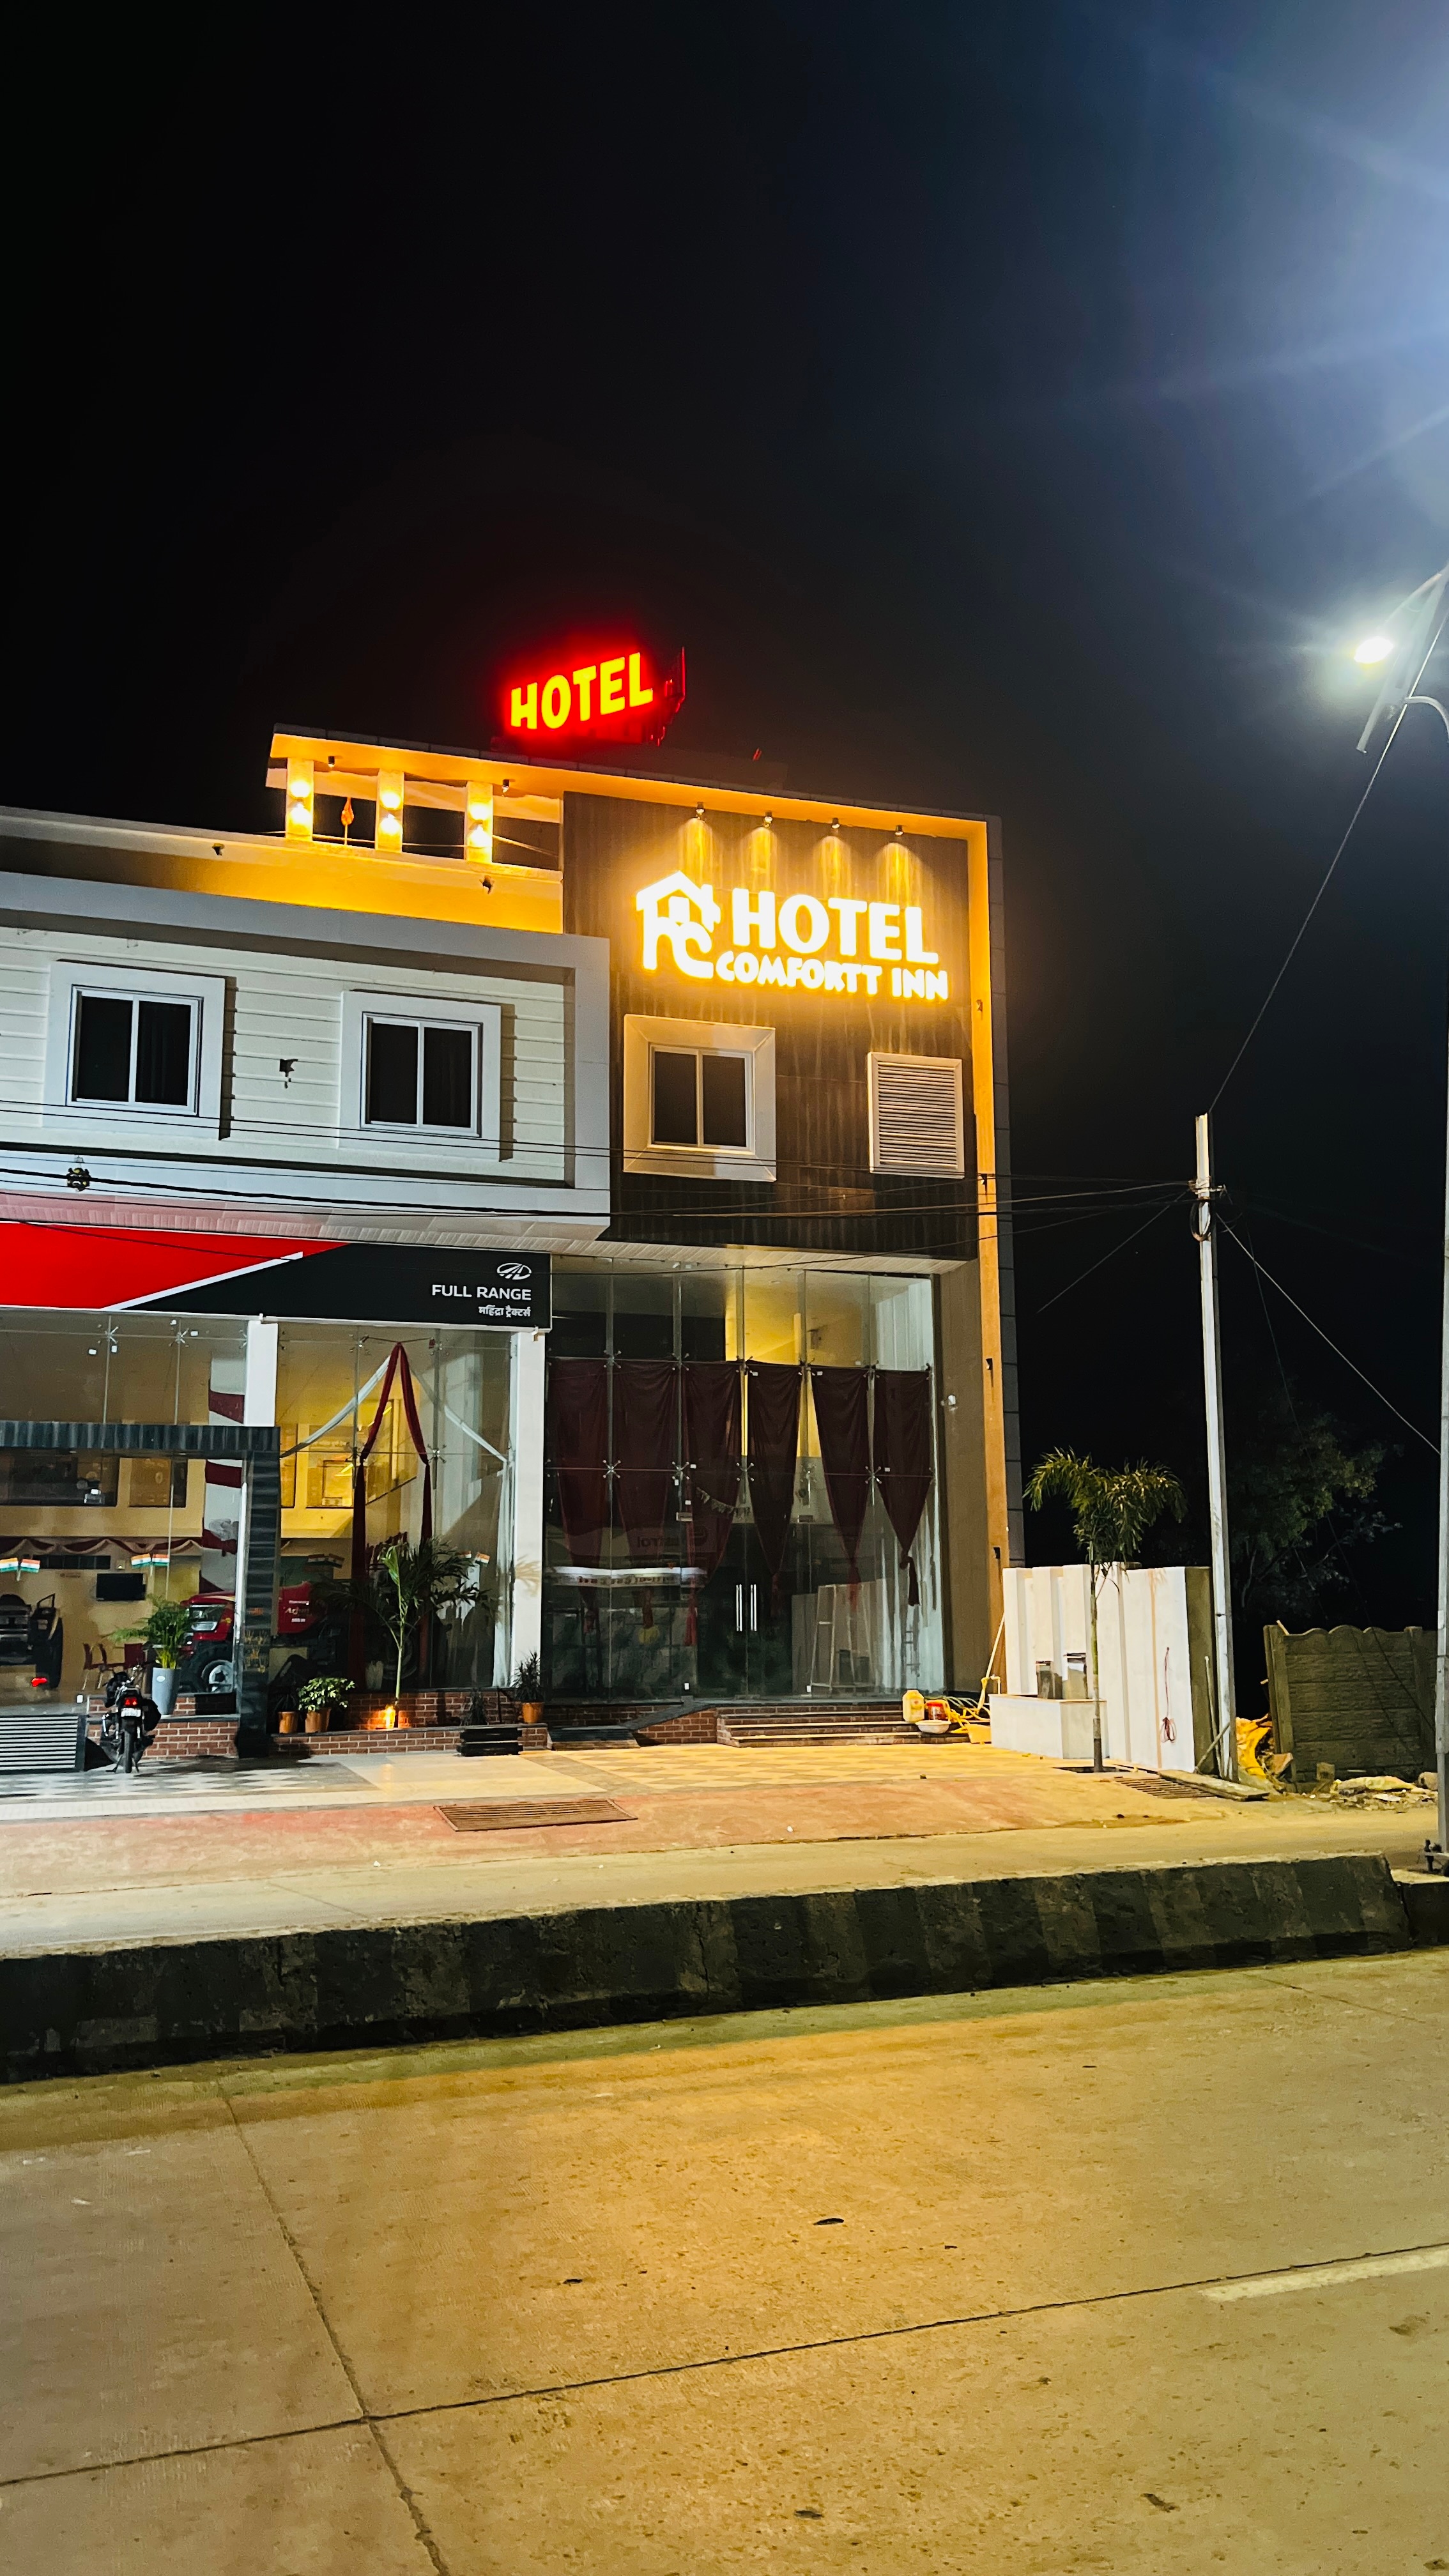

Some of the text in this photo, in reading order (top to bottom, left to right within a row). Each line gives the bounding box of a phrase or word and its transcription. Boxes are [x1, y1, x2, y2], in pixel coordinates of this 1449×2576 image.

[510, 652, 653, 730] HOTEL
[732, 887, 939, 964] HOTEL
[716, 950, 948, 1000] COMFORTT INN
[432, 1284, 532, 1300] FULL RANGE
